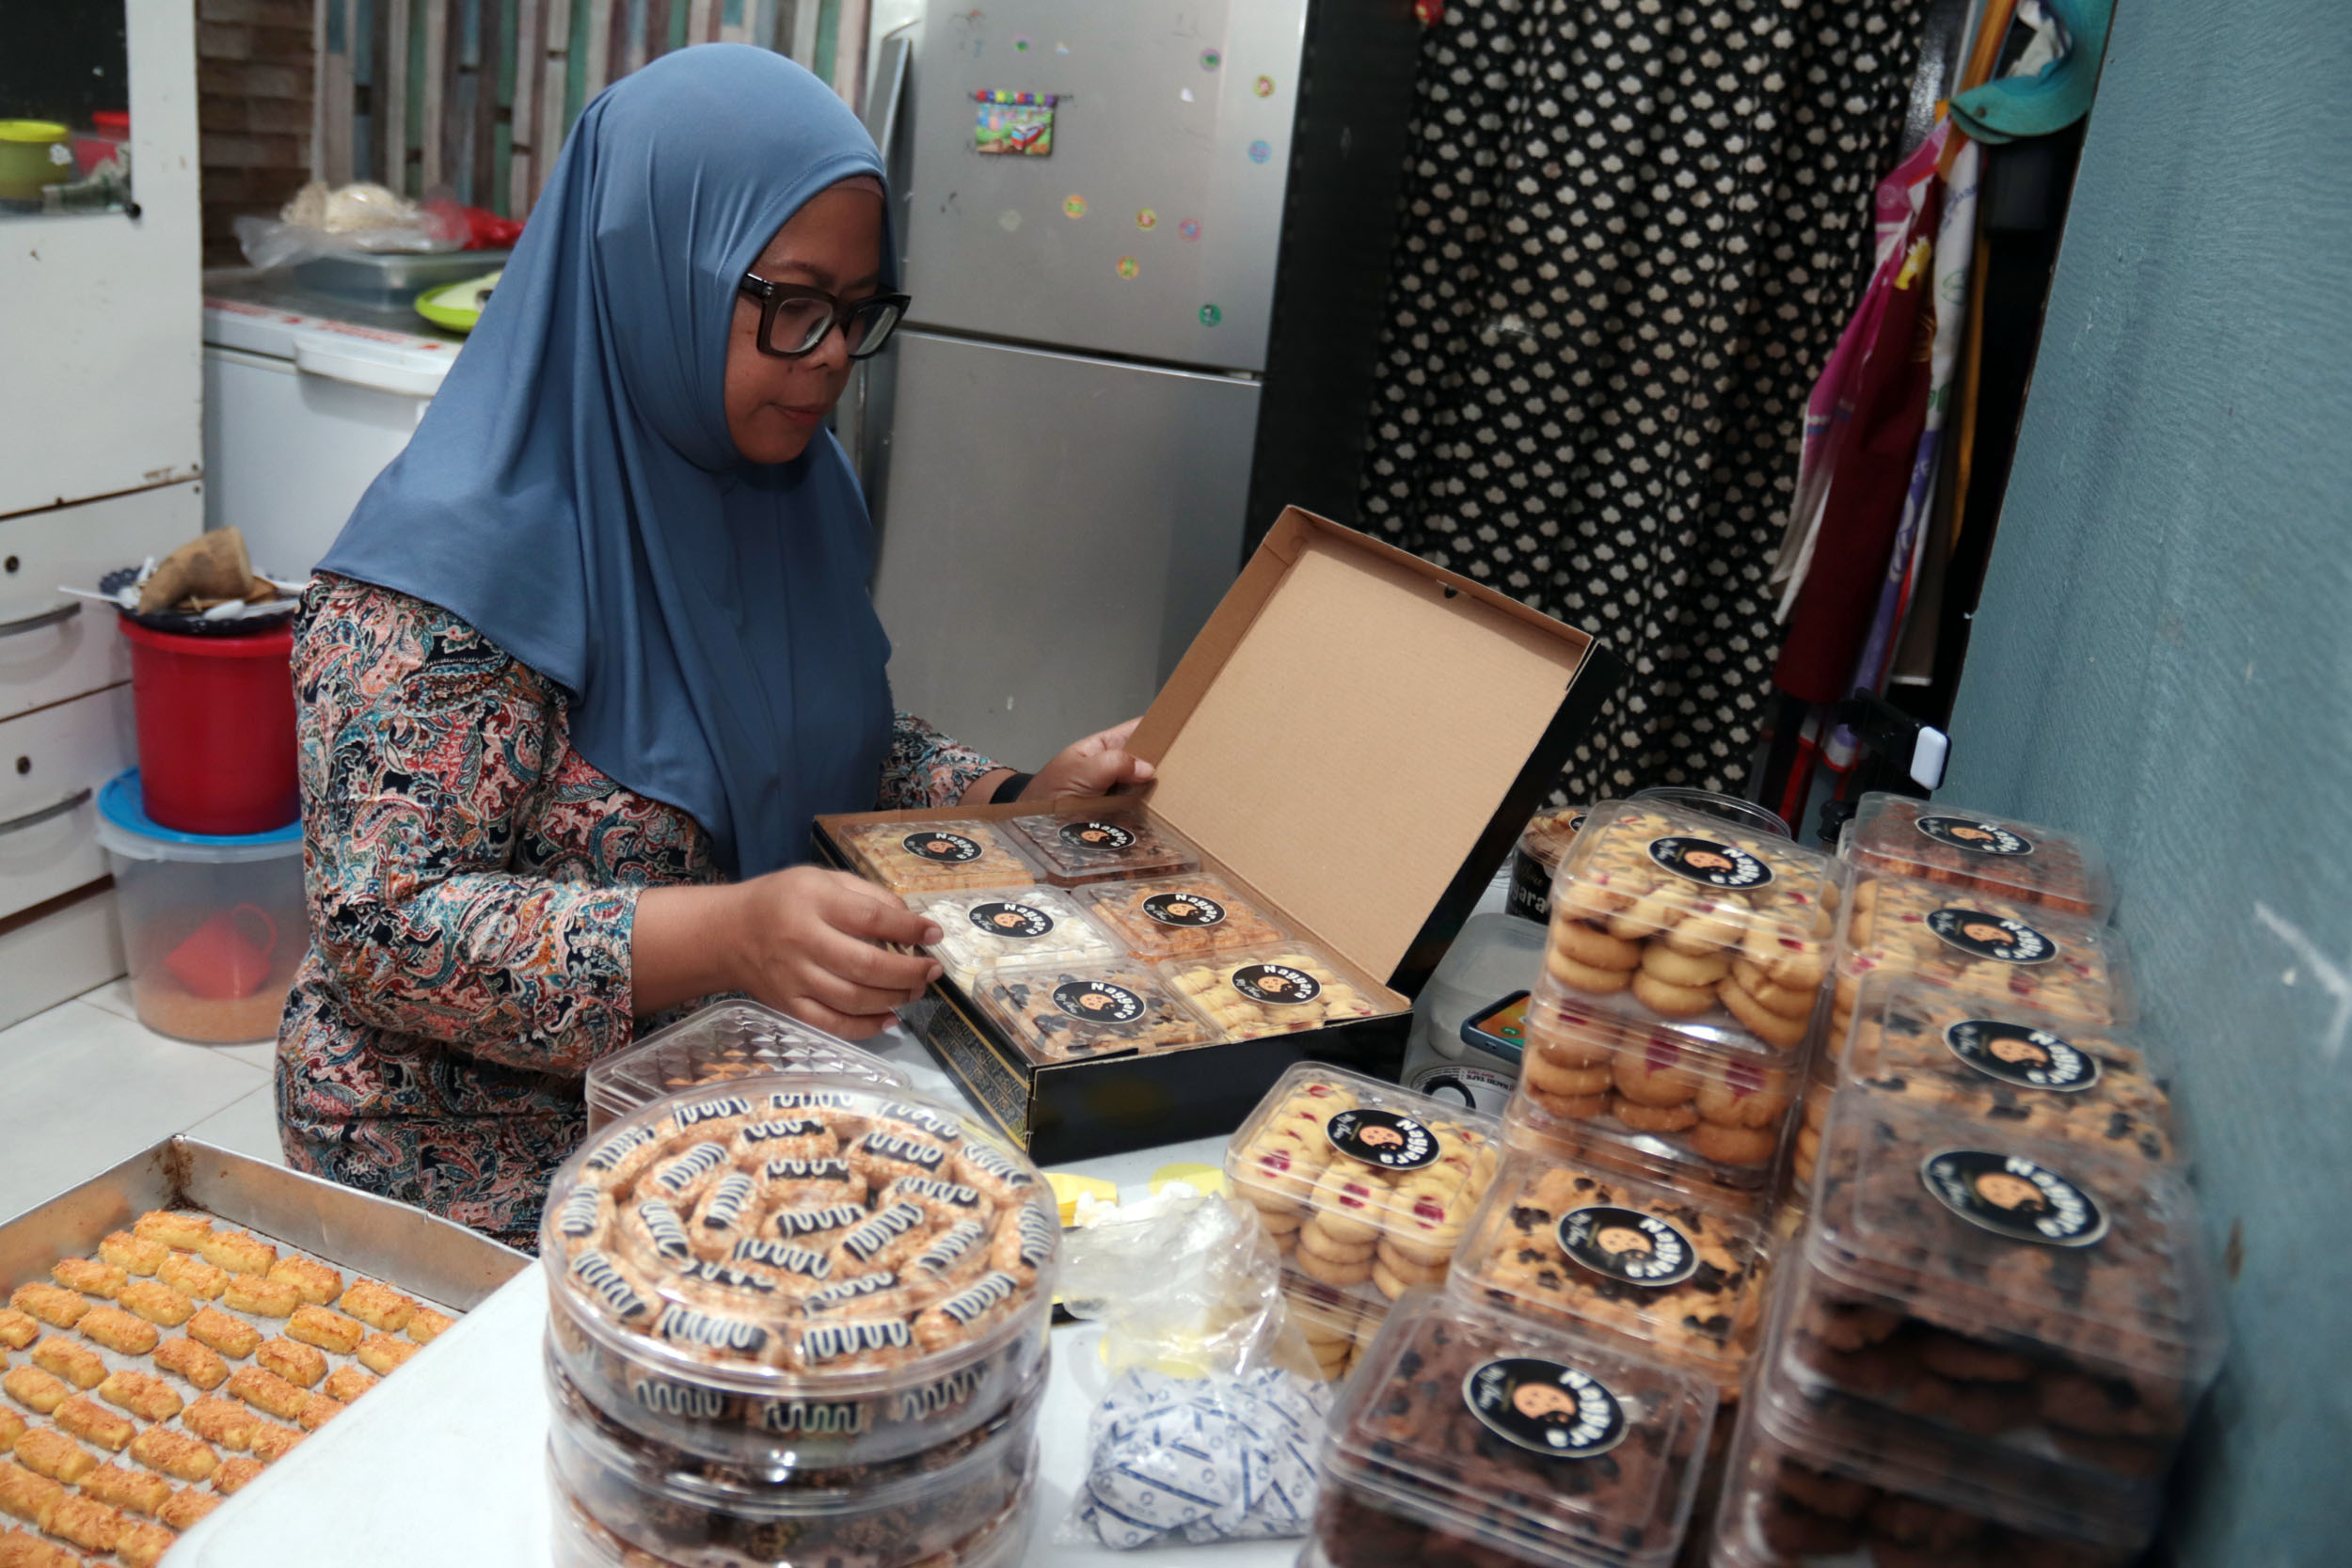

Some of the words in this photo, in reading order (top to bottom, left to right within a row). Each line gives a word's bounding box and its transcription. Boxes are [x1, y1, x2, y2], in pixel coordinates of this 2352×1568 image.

[936, 832, 976, 860] Naggara
[1089, 823, 1127, 847] Naggara
[1709, 848, 1760, 885] Naggara
[1004, 904, 1046, 935] Naggara
[1175, 895, 1217, 922] Naggara
[1263, 965, 1312, 999] Naggara
[1091, 982, 1136, 1019] Naggara
[1379, 1119, 1429, 1164] Naggara
[1625, 1217, 1683, 1278] Naggara
[1545, 1370, 1613, 1448] Naggara
